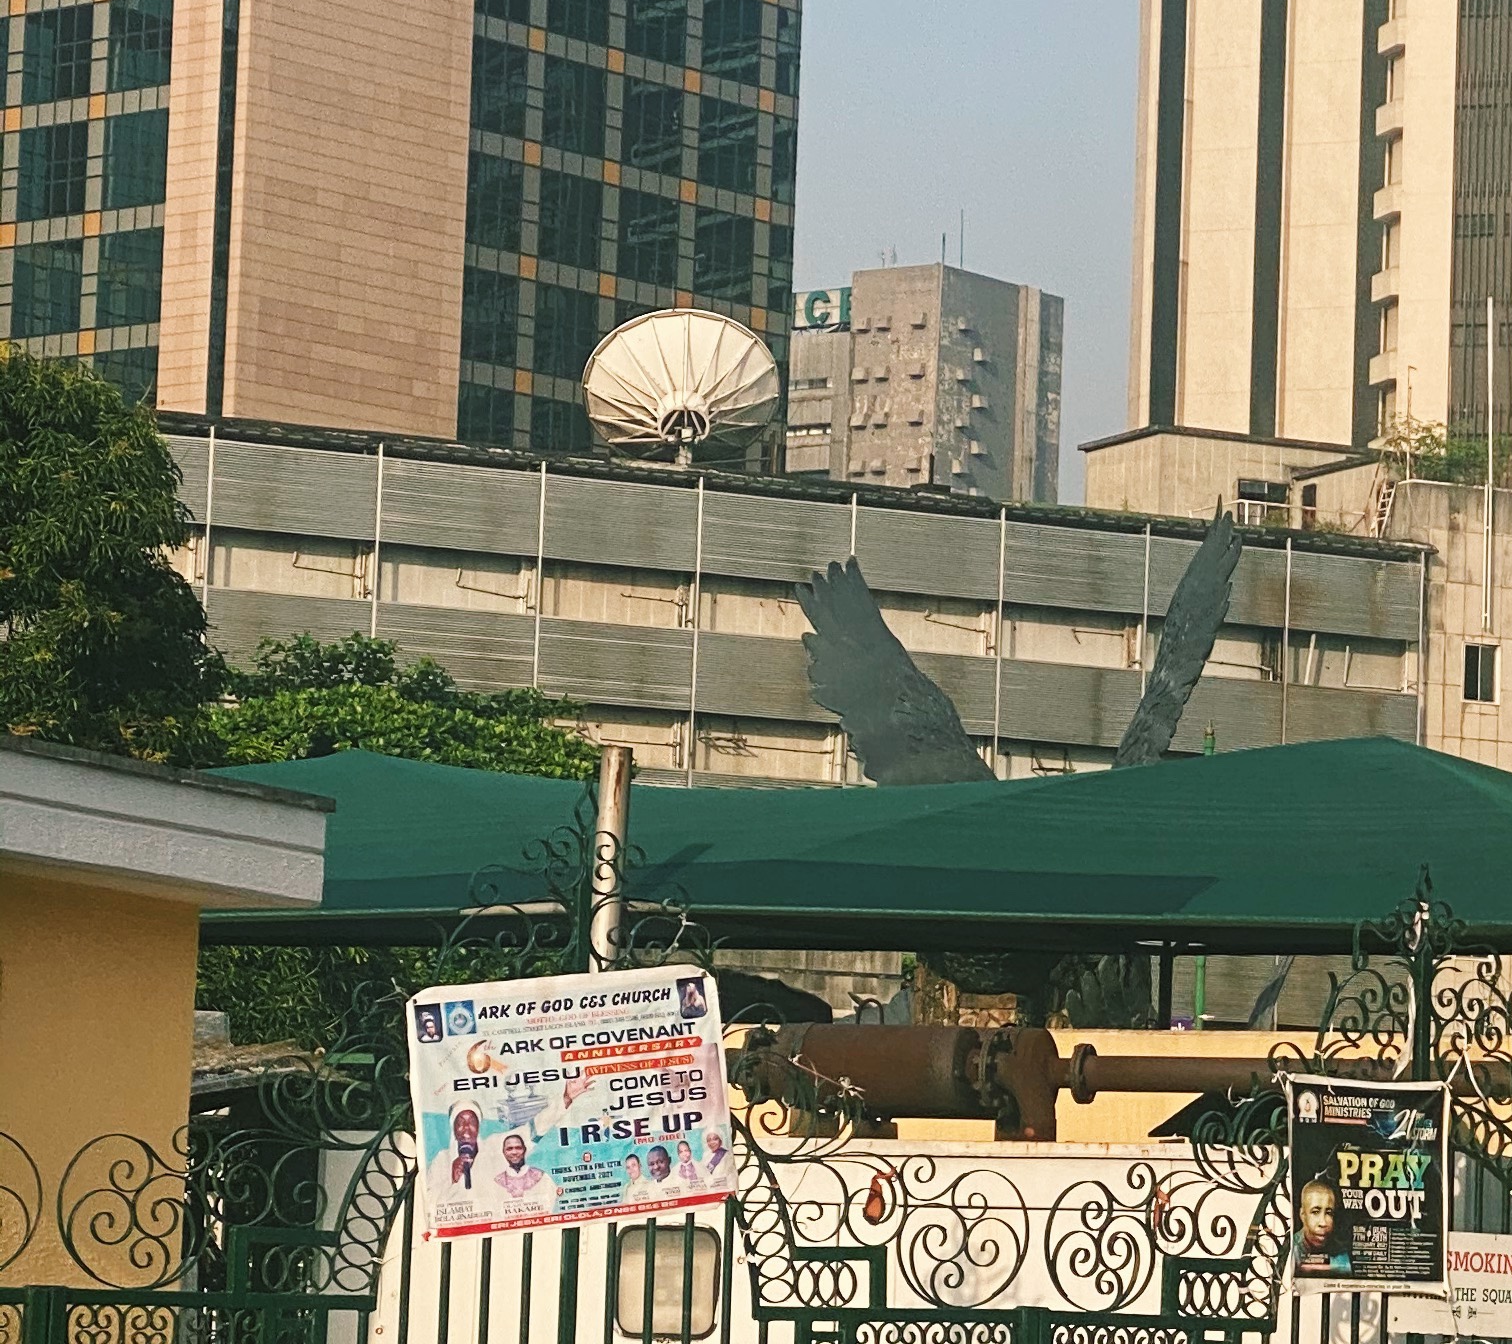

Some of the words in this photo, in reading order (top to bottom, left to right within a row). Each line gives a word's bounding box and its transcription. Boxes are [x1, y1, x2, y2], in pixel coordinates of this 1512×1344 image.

[478, 1004, 511, 1020] ARK
[516, 1001, 536, 1016] OF
[541, 998, 573, 1014] GOD
[579, 992, 607, 1009] C&S
[612, 987, 671, 1006] CHURCH
[500, 1039, 545, 1055] ARK
[550, 1035, 578, 1050] OF
[582, 1022, 696, 1046] COVENANT
[563, 1038, 699, 1061] ANNIVERSARY
[639, 1059, 654, 1069] OF
[453, 1076, 498, 1092] ERI
[505, 1066, 581, 1086] JESU
[609, 1073, 671, 1092] COME
[675, 1069, 703, 1085] TO
[608, 1087, 708, 1111] JESUS
[1323, 1096, 1367, 1107] SALVATION
[1369, 1098, 1378, 1107] OF
[1380, 1099, 1395, 1109] GOD
[1324, 1106, 1372, 1119] MINISTRIES
[559, 1127, 570, 1147] I
[662, 1111, 703, 1134] UP
[1388, 1109, 1417, 1140] 21
[1336, 1151, 1432, 1189] PRAY
[1341, 1189, 1364, 1199] YOUR
[1342, 1199, 1363, 1209] WAY
[1364, 1188, 1425, 1219] OUT
[490, 1222, 510, 1230] ERI
[544, 1216, 562, 1224] ERI
[1455, 1287, 1477, 1302] THE
